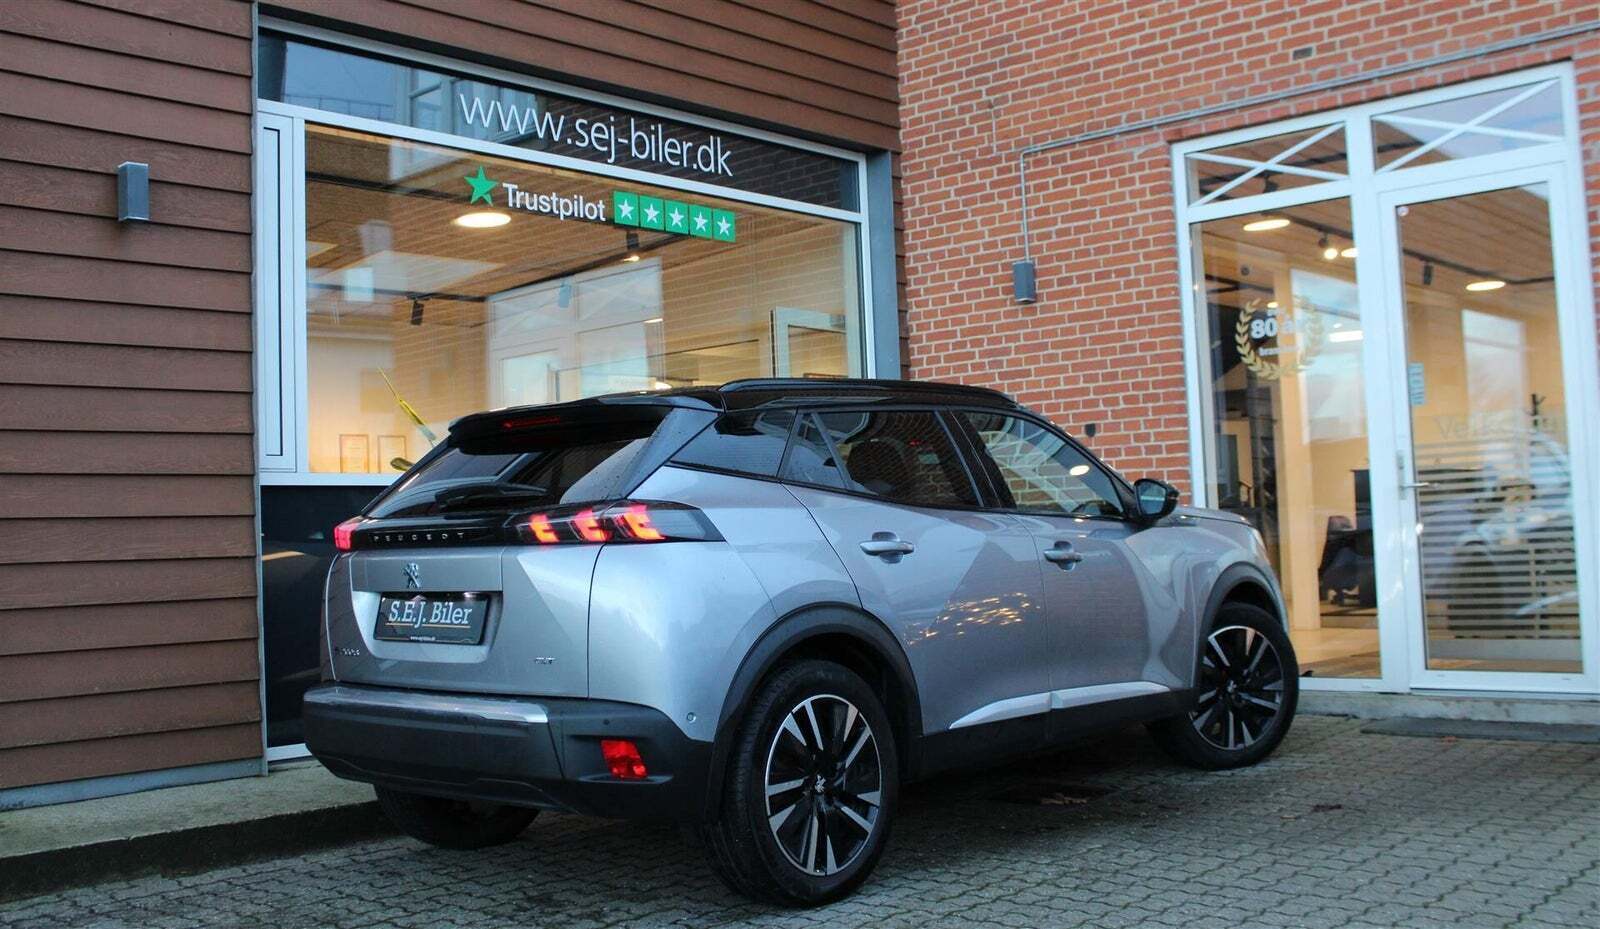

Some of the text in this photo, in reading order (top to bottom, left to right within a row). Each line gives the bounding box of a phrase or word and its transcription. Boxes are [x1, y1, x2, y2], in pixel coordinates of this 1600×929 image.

[459, 93, 733, 177] www.sej-biler.dk
[502, 182, 607, 221] Trustpilot
[388, 601, 472, 628] S.E.J. Biler
